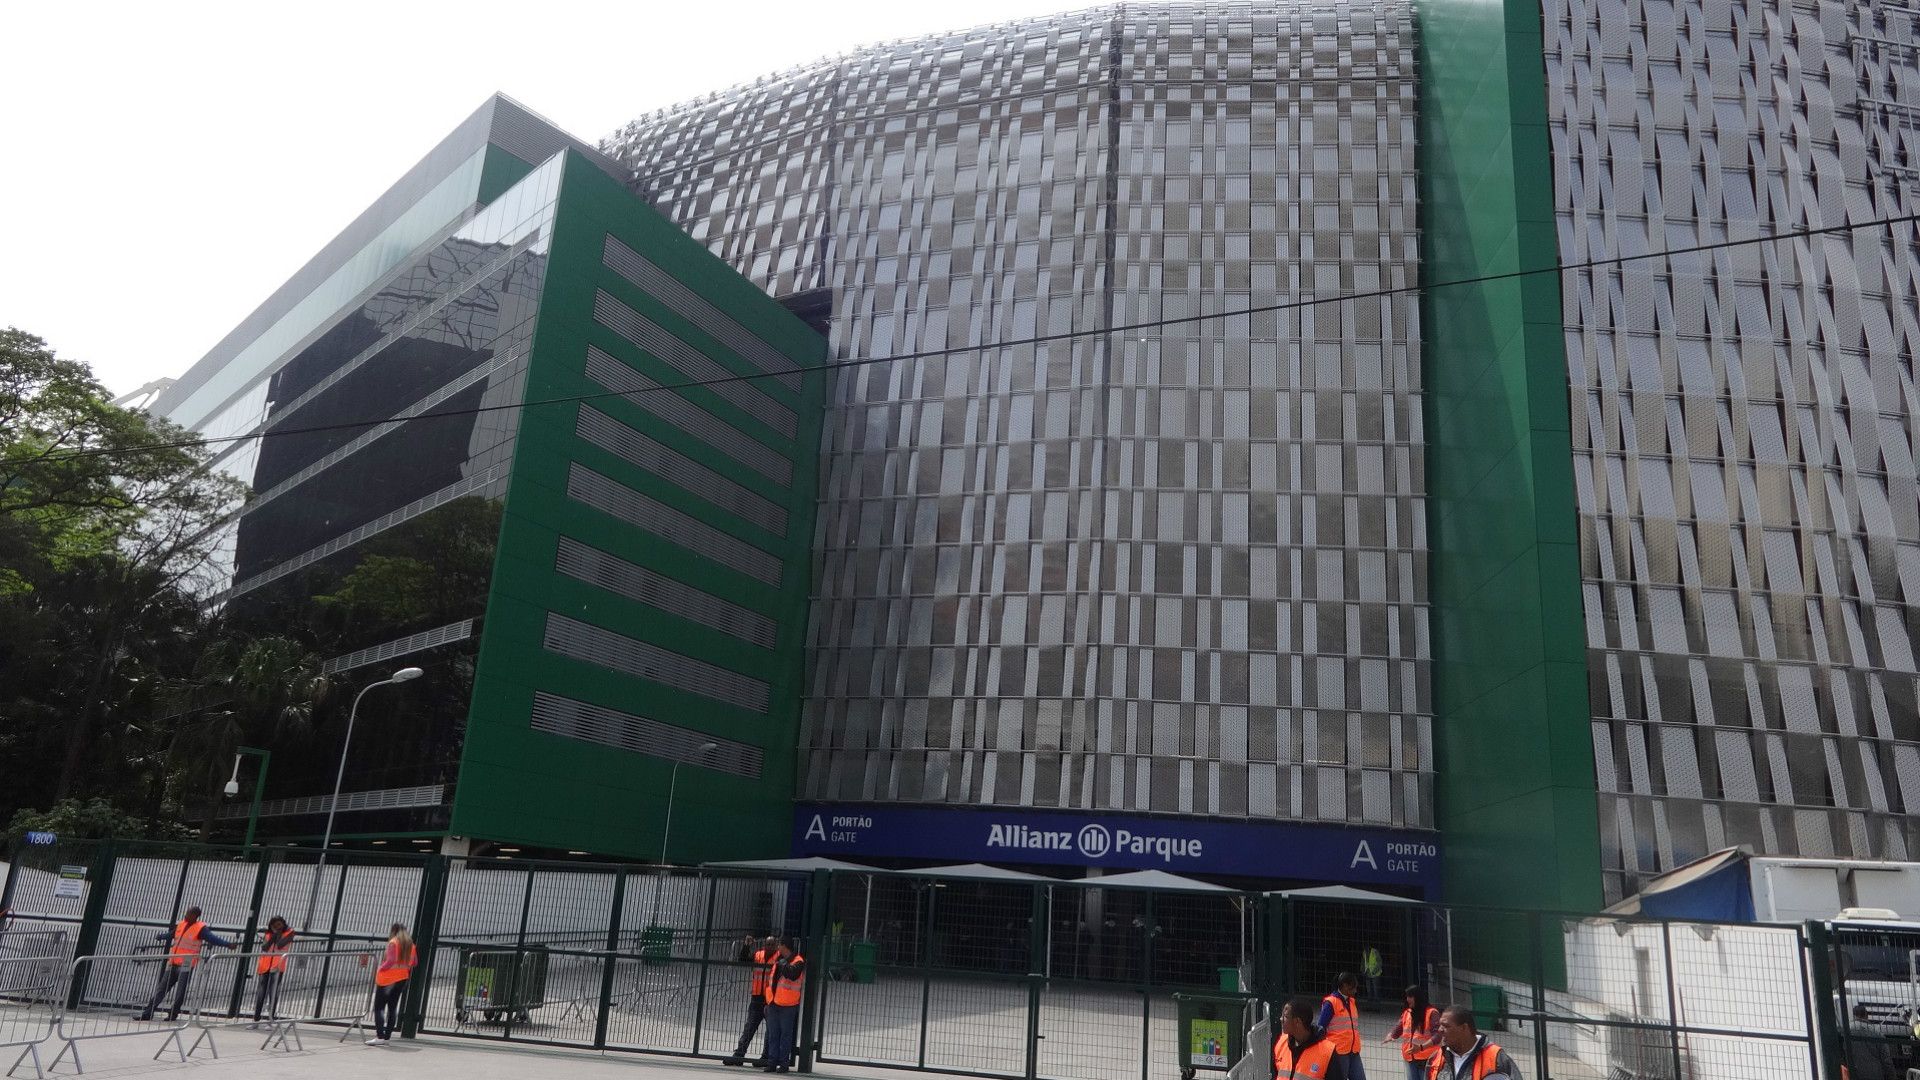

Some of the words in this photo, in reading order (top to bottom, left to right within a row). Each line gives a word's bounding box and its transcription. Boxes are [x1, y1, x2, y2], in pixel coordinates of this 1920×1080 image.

[805, 814, 826, 841] A
[832, 815, 872, 828] PORTÃO
[30, 833, 53, 845] 1800
[831, 831, 857, 843] GATE
[987, 824, 1072, 850] Allianz
[1116, 830, 1202, 862] Parque
[1350, 840, 1378, 870] A
[1387, 842, 1436, 857] PORTÃO
[1387, 859, 1419, 872] GATE
